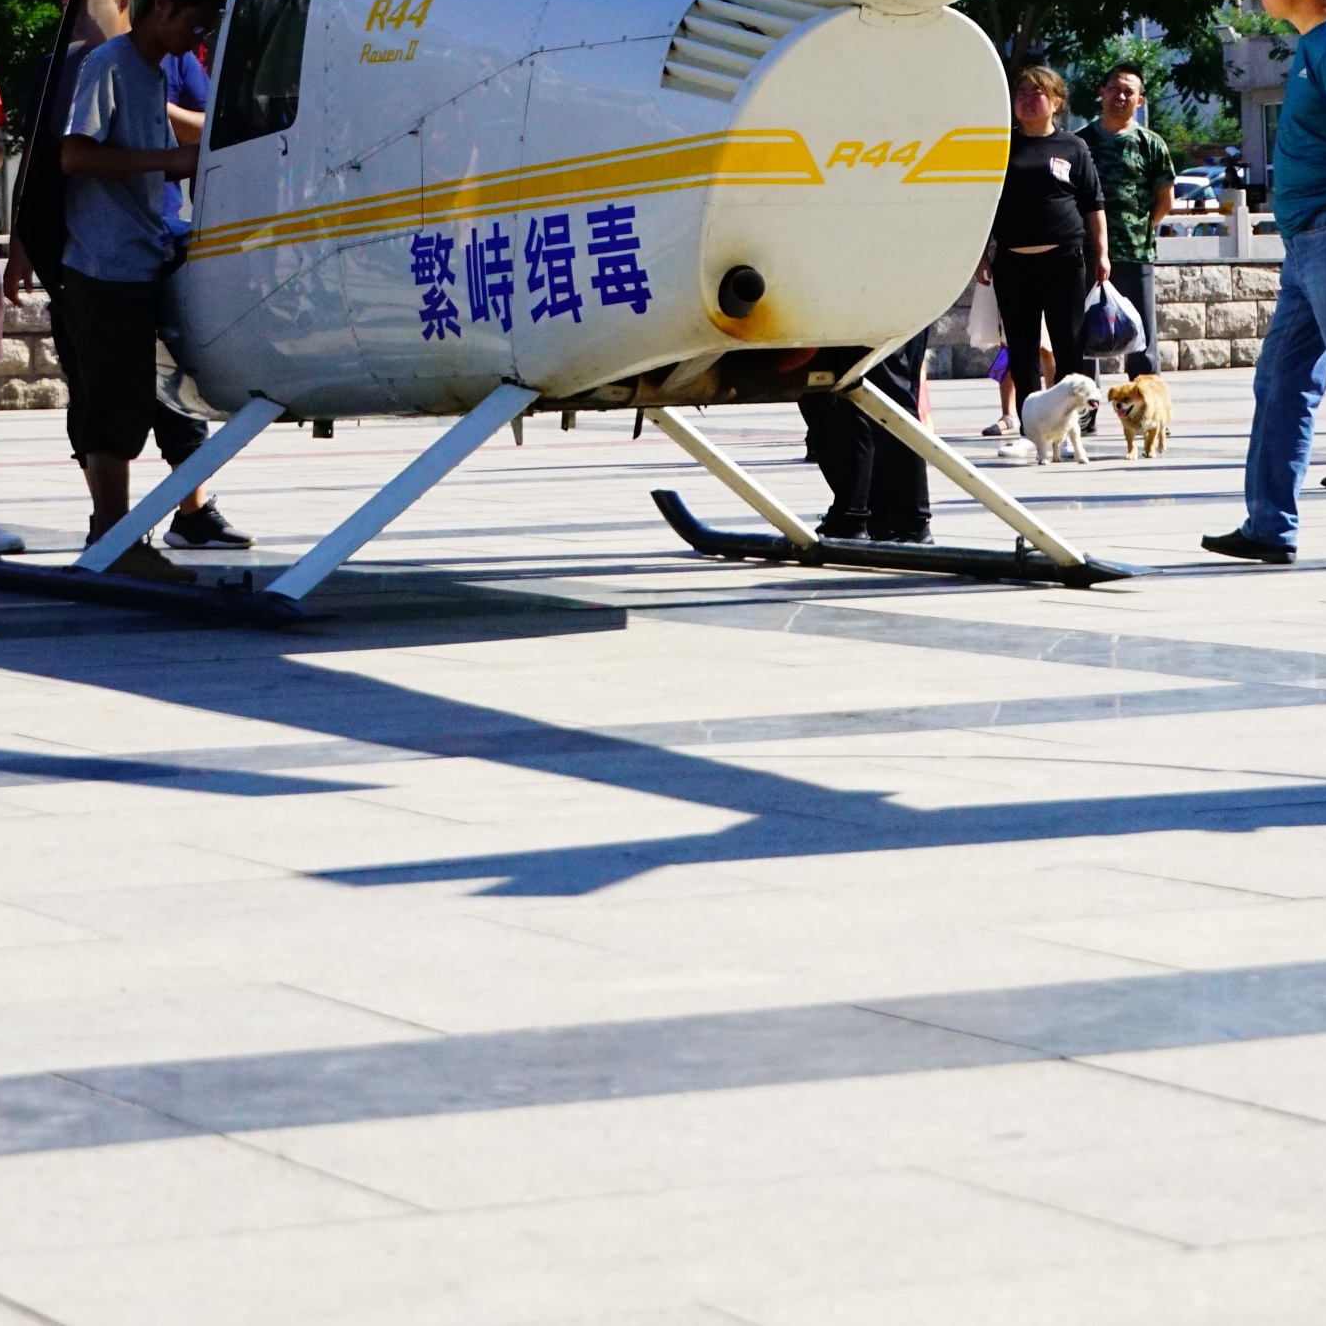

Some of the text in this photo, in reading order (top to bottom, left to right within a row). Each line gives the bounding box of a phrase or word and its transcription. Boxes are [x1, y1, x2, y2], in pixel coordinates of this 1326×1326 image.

[360, 44, 403, 63] Raven
[825, 140, 922, 168] R44
[409, 204, 653, 341] 繁峙缉毒
